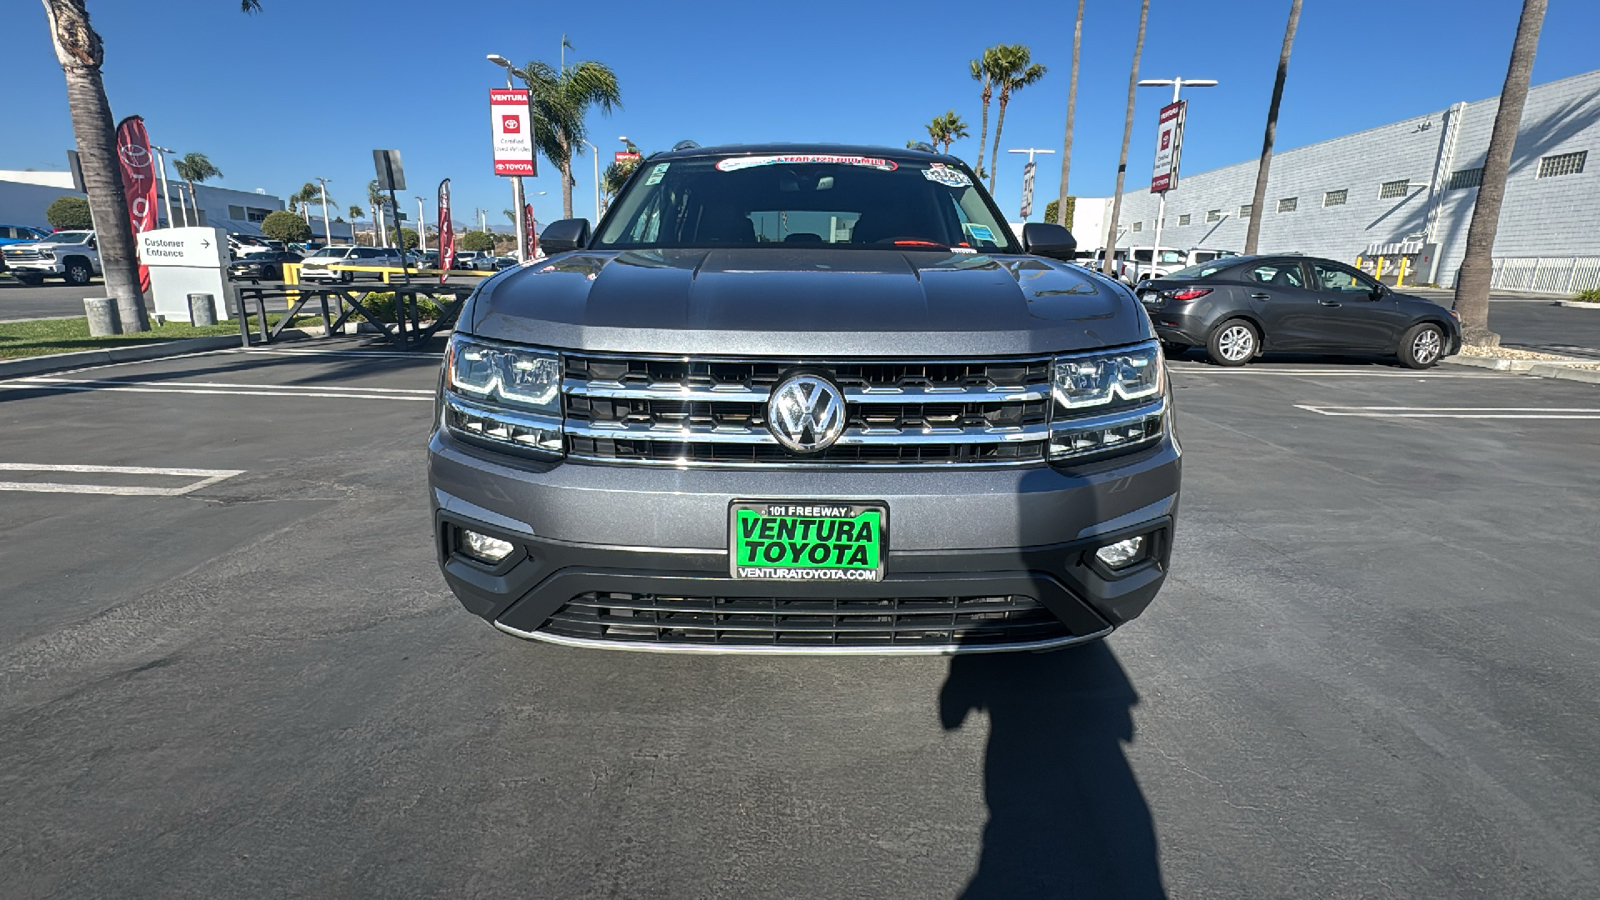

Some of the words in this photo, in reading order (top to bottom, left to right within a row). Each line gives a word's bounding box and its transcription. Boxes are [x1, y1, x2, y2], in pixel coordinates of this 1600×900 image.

[504, 163, 533, 171] TOYOTA
[144, 238, 184, 247] Customer
[146, 248, 184, 257] Entrance
[769, 506, 786, 516] 101
[788, 507, 848, 517] FREEWAY
[741, 517, 873, 543] VENTURA
[744, 540, 869, 566] TOYOTA
[738, 567, 877, 580] VENTURATOYOTA.COM
